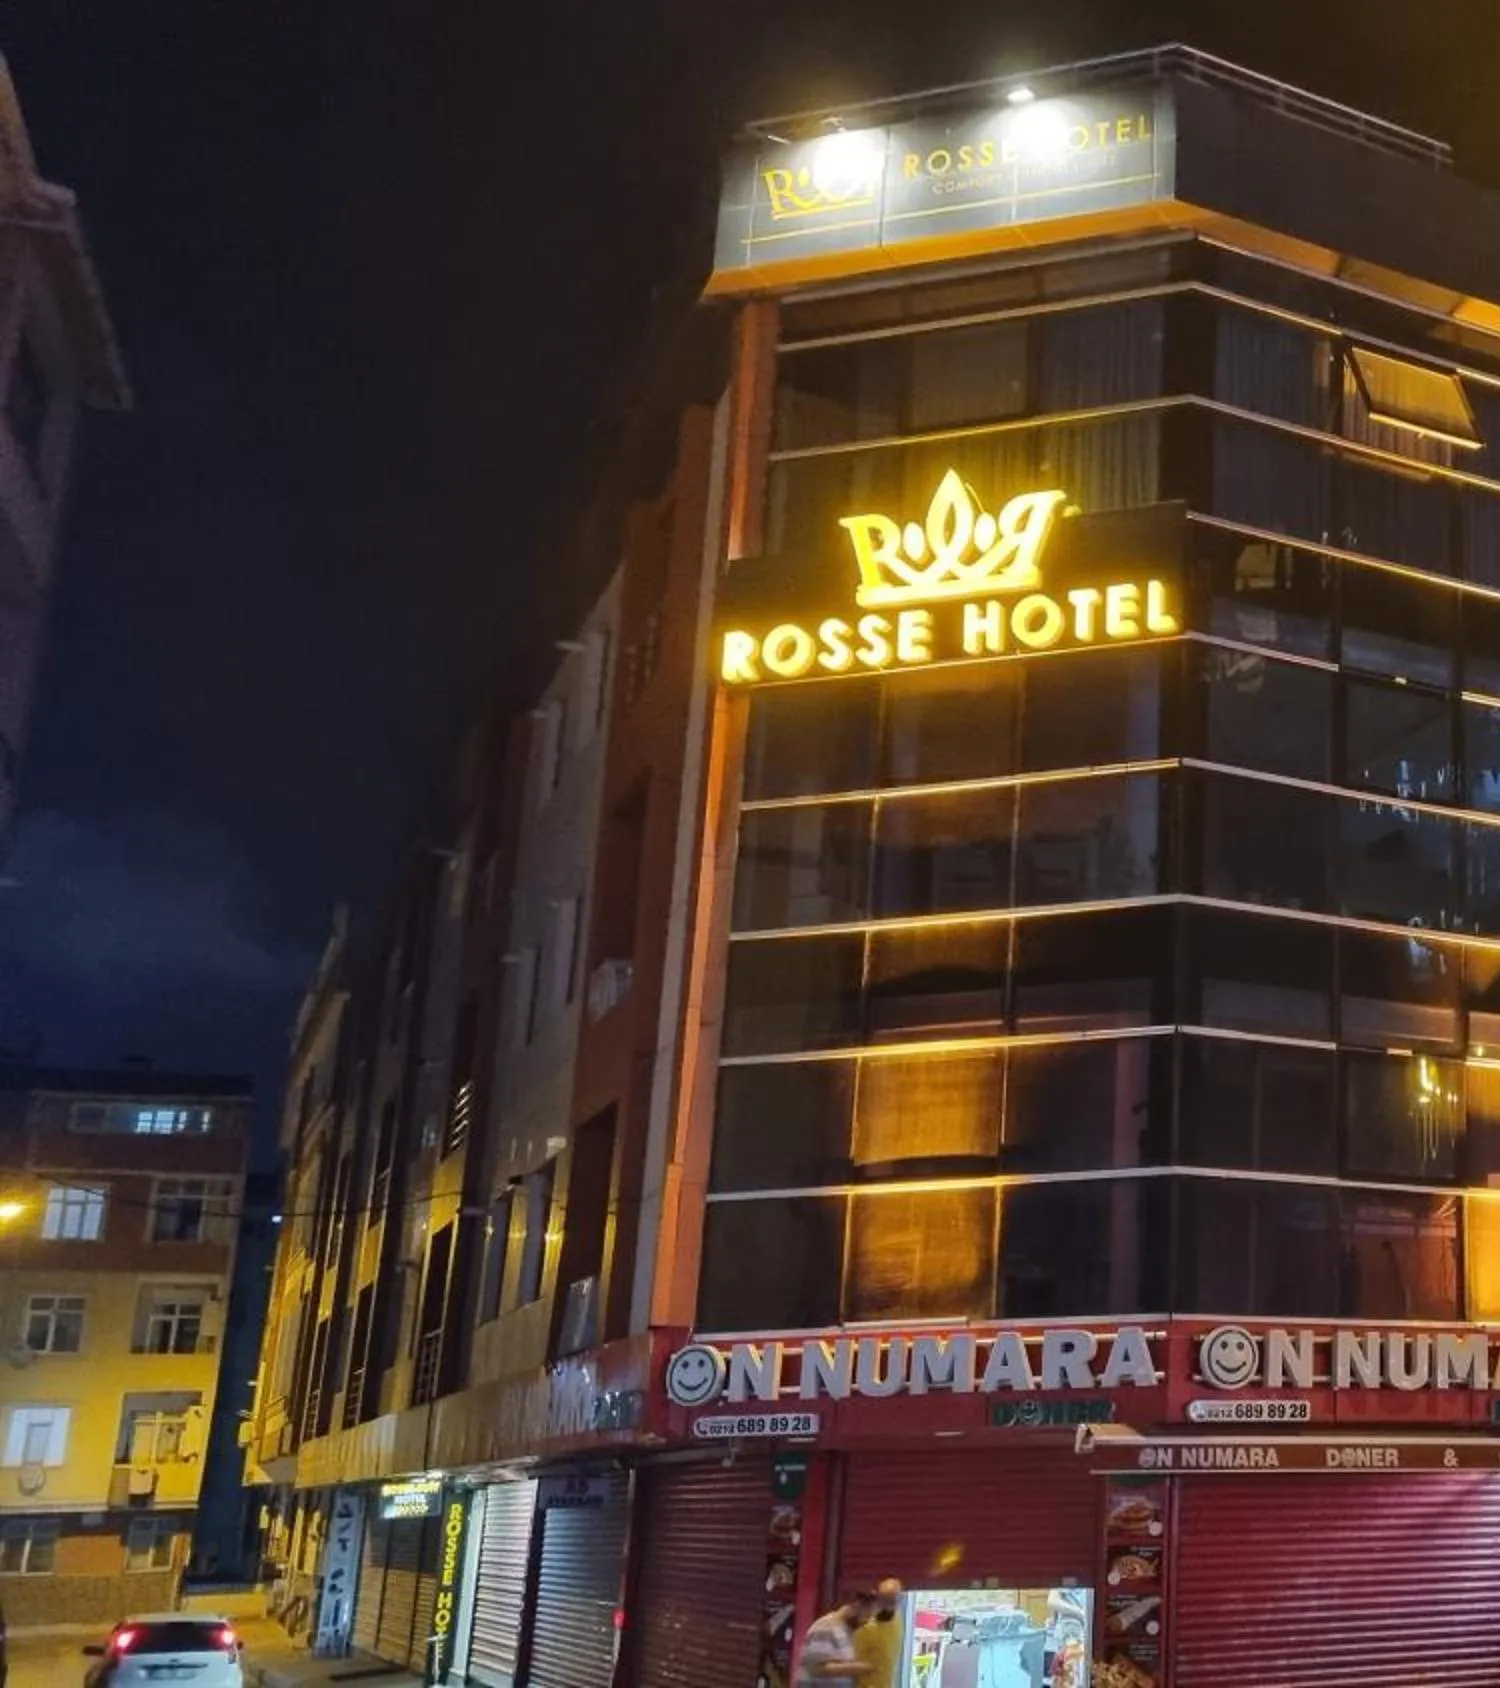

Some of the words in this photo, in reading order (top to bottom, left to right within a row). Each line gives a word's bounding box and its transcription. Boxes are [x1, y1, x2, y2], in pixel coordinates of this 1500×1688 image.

[721, 609, 933, 684] ROSSE
[962, 578, 1181, 658] HOTEL
[799, 1326, 1160, 1400] NUMARA
[737, 1418, 766, 1433] 689
[769, 1416, 789, 1432] 89
[791, 1415, 812, 1431] 28
[1235, 1403, 1263, 1419] 689
[1267, 1403, 1287, 1419] 89
[1289, 1403, 1308, 1419] 28
[1181, 1447, 1280, 1467] NUMARA
[1443, 1448, 1460, 1467] &
[442, 1504, 464, 1585] ROSSE
